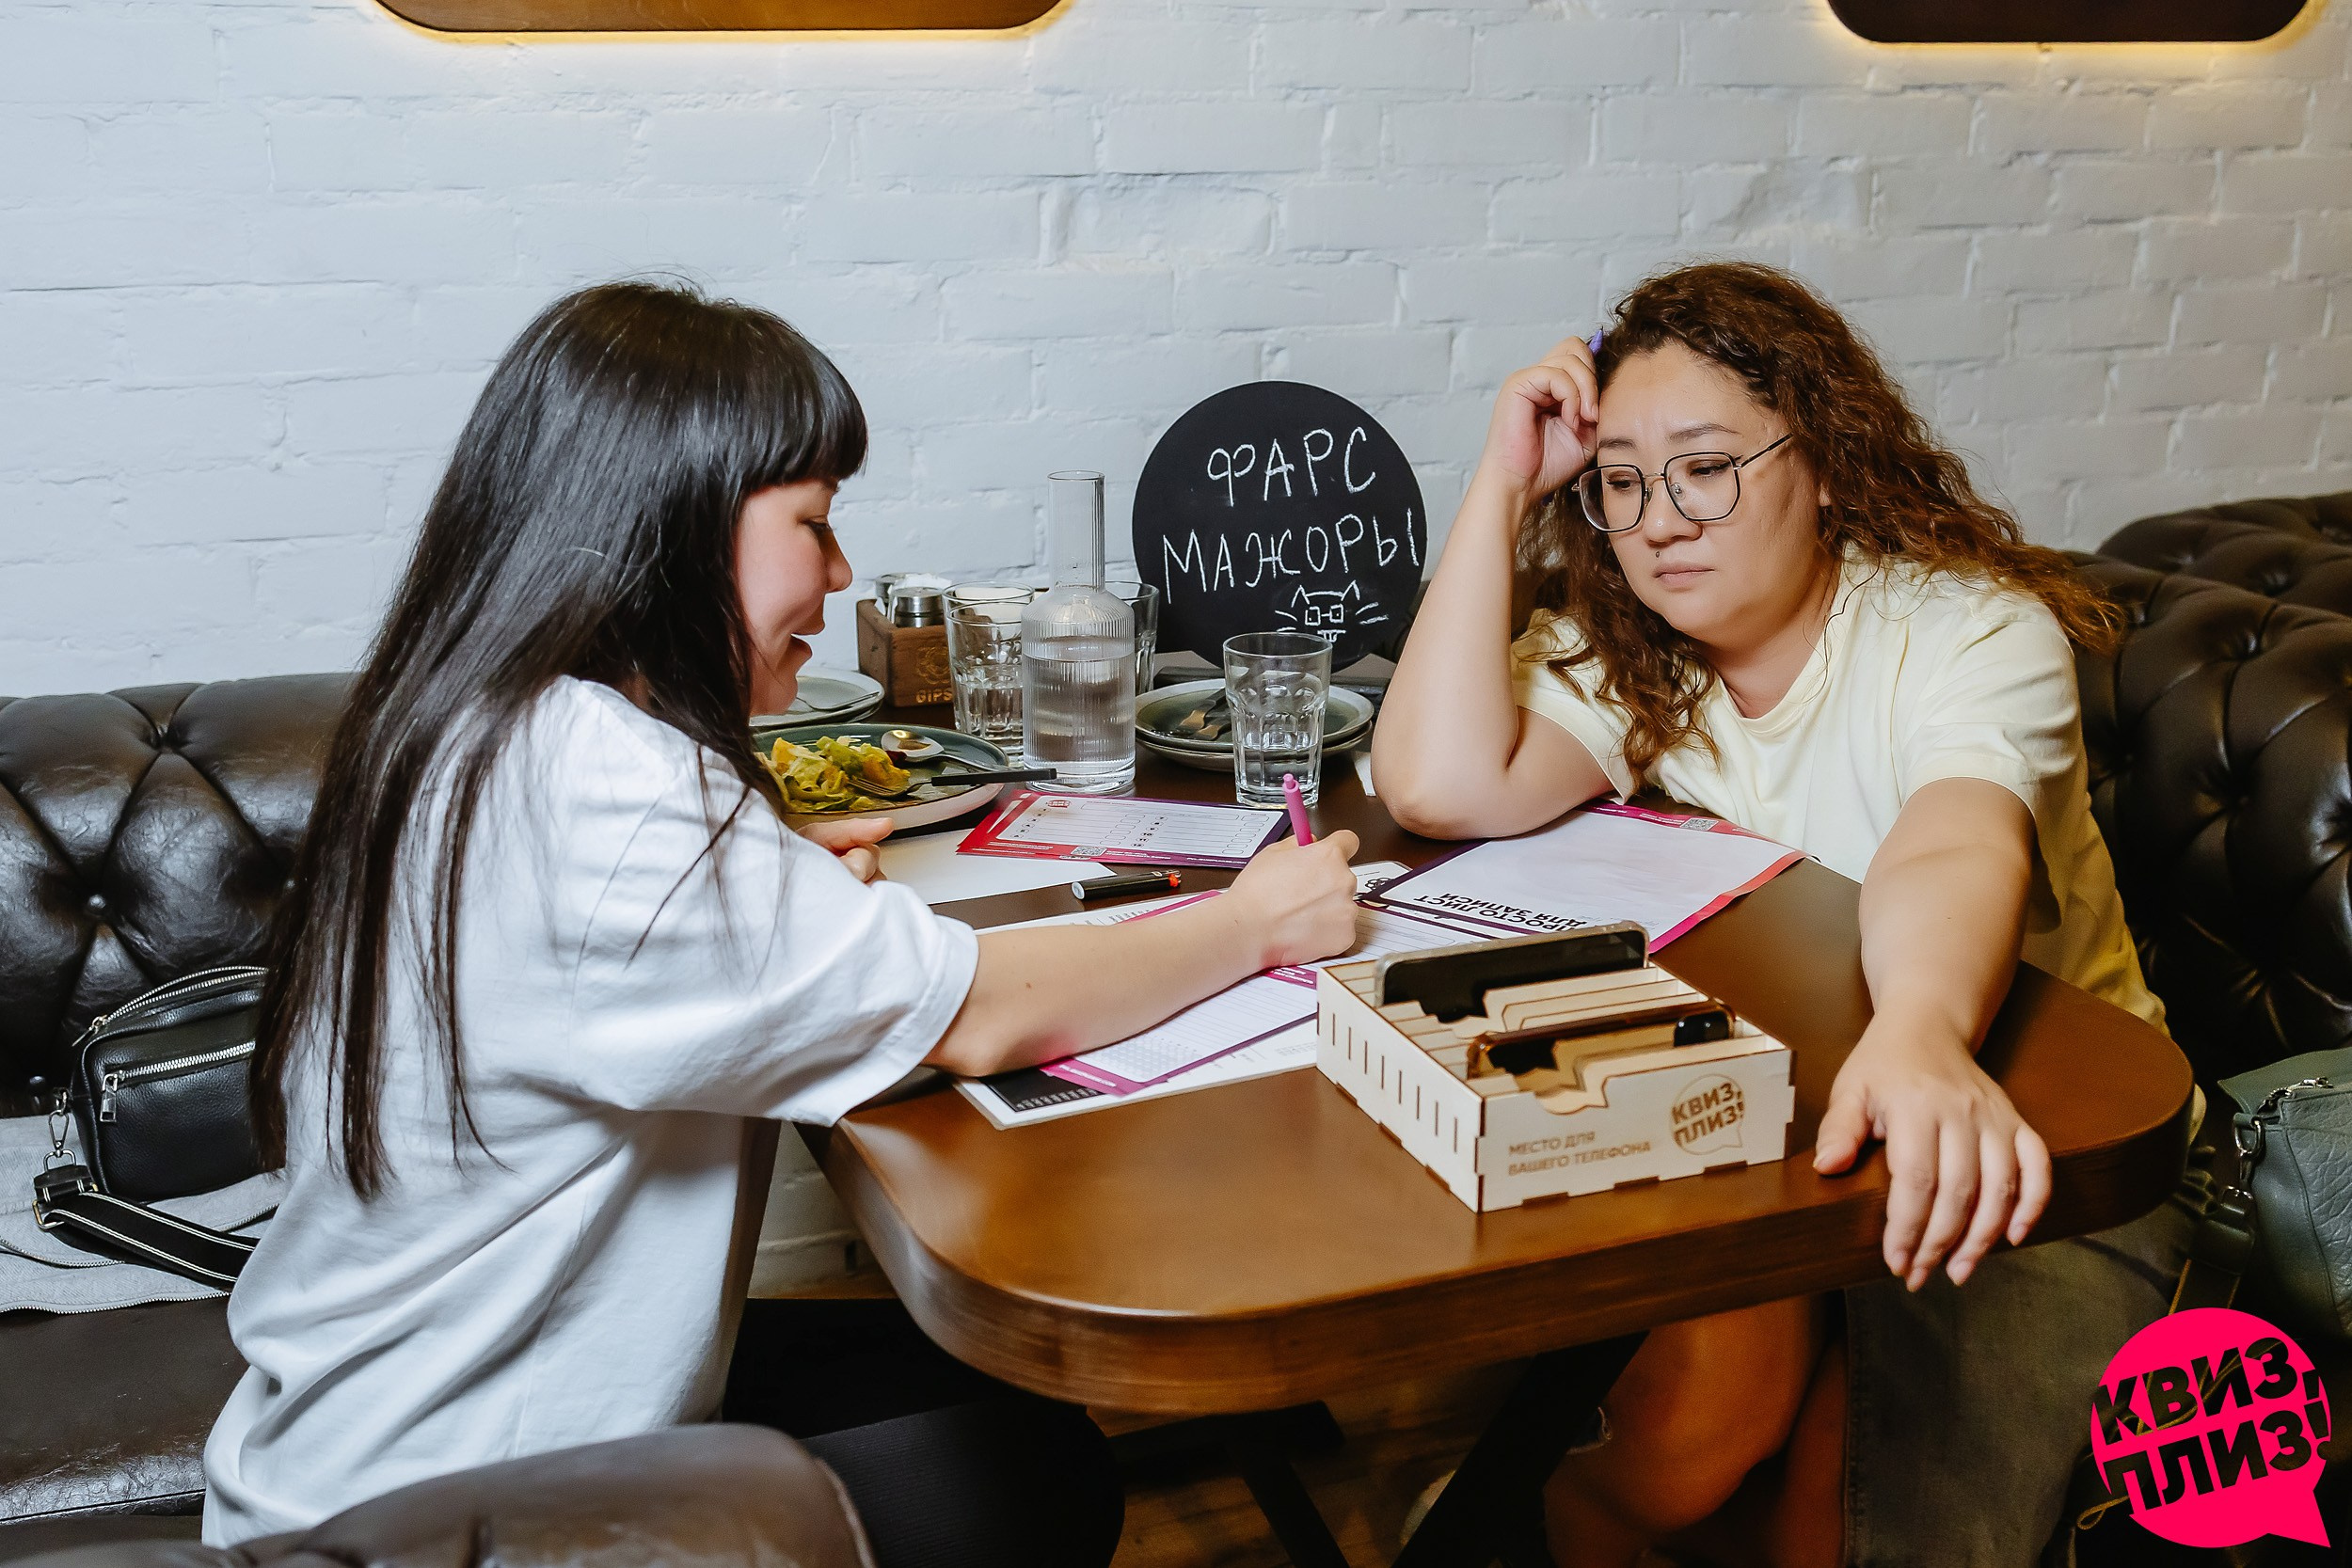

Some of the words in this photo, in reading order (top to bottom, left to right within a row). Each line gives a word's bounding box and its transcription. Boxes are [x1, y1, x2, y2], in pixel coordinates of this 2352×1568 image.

[1207, 426, 1376, 507] ФАРС
[1163, 507, 1420, 605] МАЖОРЫ
[915, 689, 953, 704] GIPS
[1413, 895, 1476, 912] ЛИСТ
[1439, 893, 1533, 916] ЗАПИСИ
[1534, 912, 1587, 927] ДЛЯ
[1671, 1083, 1742, 1125] КВИЗ,
[1674, 1101, 1744, 1148] ПЛИЗ!
[1508, 1138, 1561, 1157] МЕСТО
[1565, 1131, 1596, 1148] ДЛЯ
[1508, 1154, 1570, 1176] ВАШЕГО
[1574, 1140, 1651, 1166] ТЕЛЕФОНА
